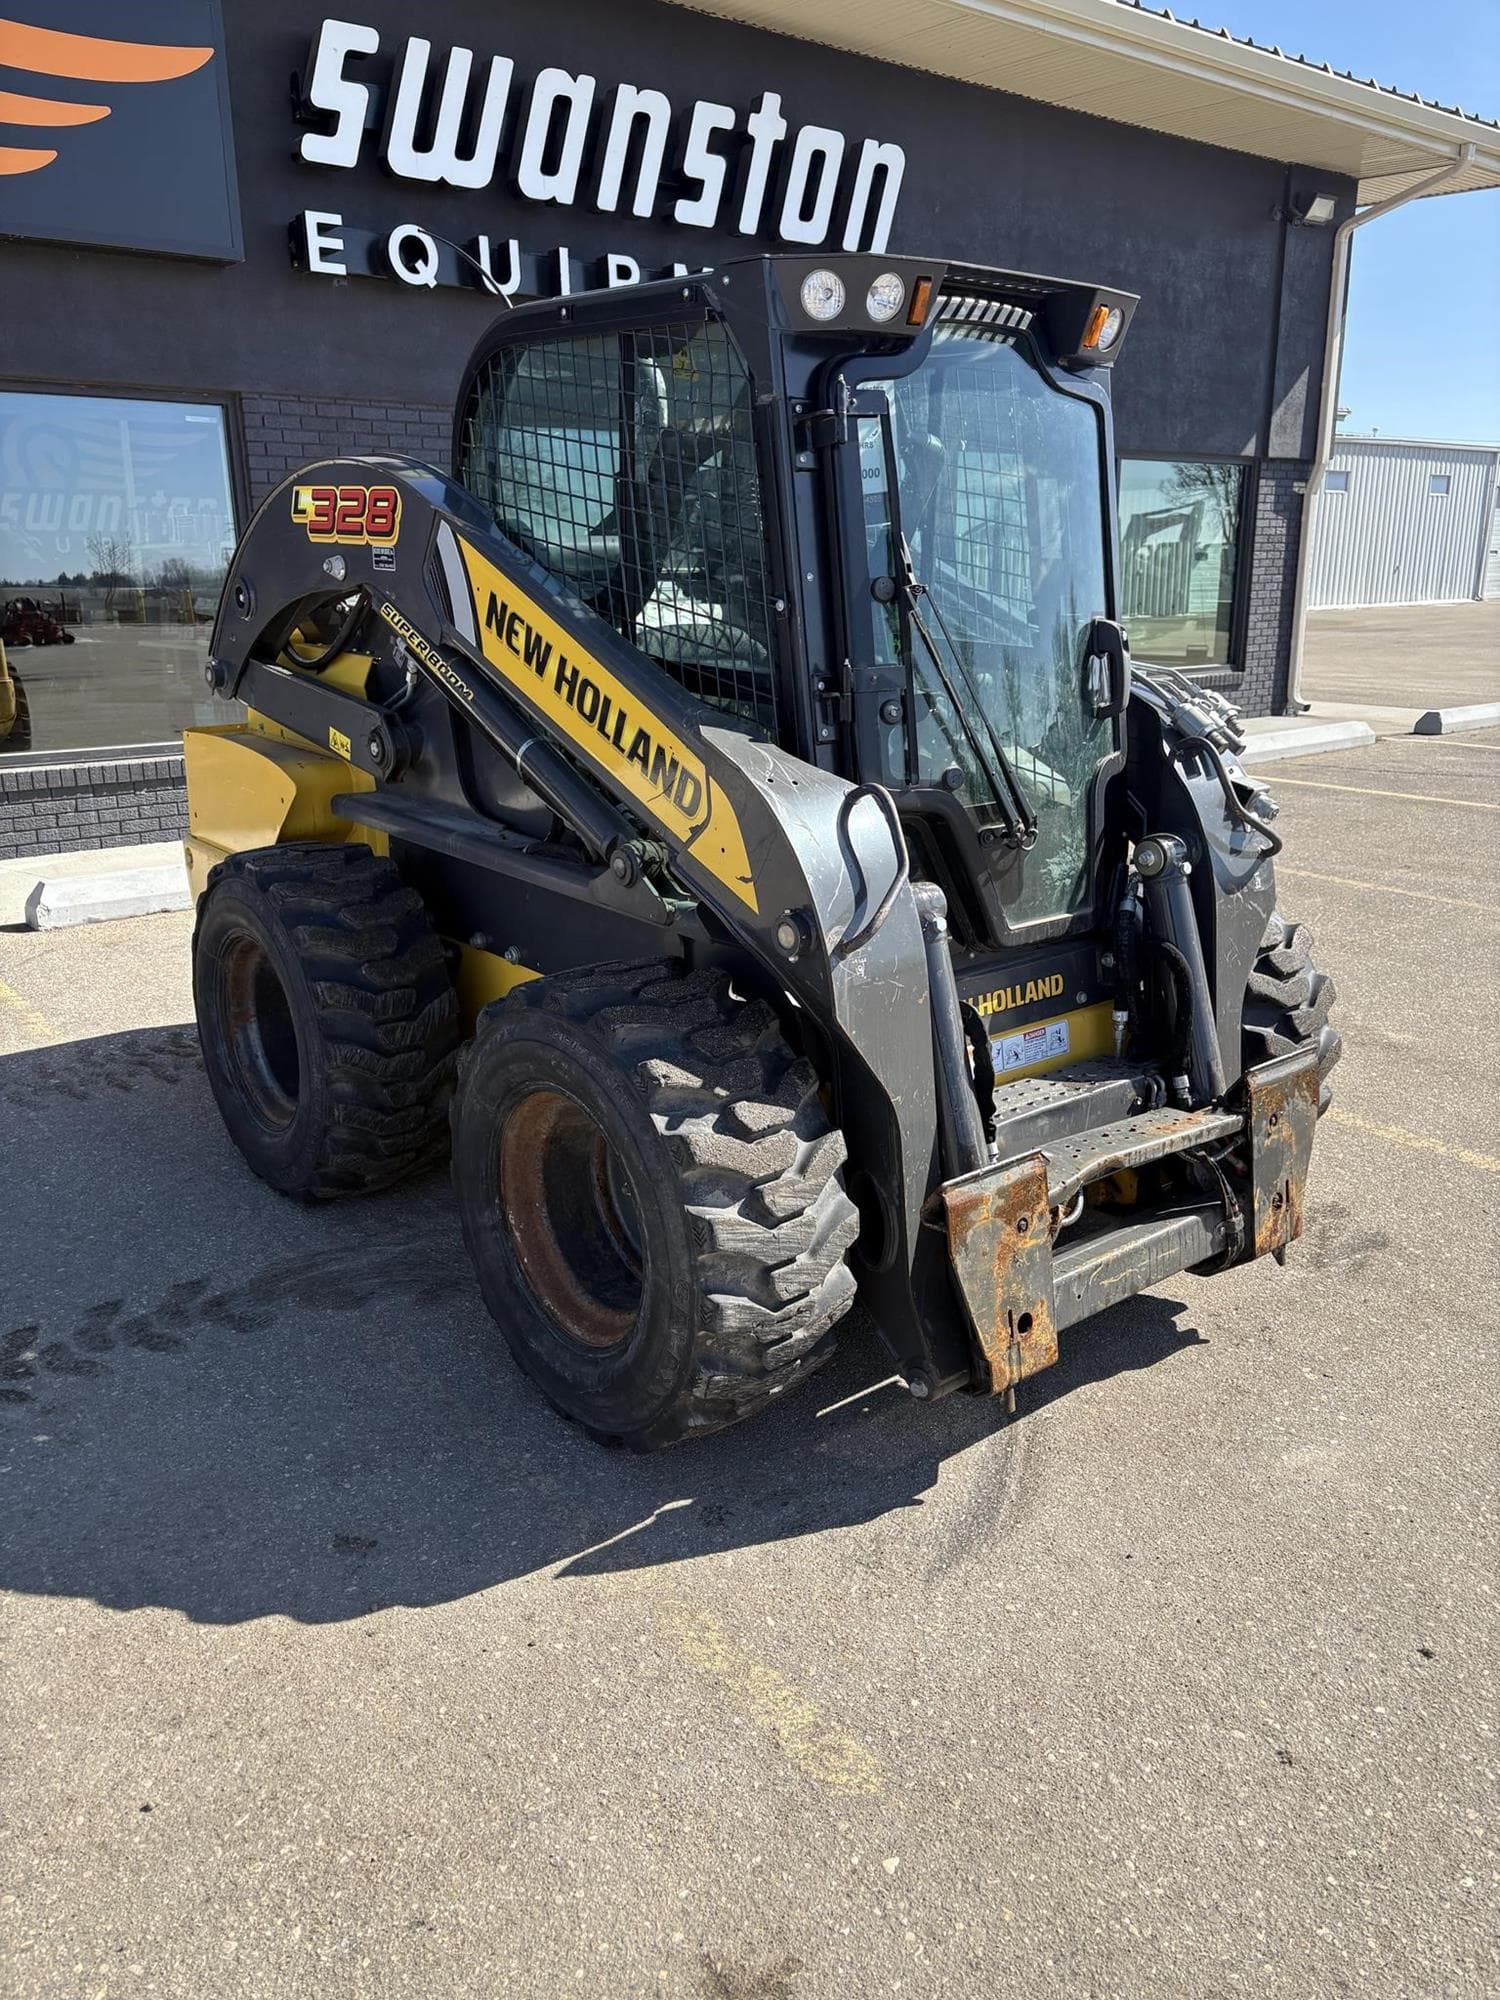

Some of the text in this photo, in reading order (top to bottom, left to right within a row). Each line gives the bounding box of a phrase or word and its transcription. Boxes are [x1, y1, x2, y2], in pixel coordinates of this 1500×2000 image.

[292, 487, 401, 544] L328
[485, 591, 702, 818] NEW HOLLAND
[976, 973, 1065, 1017] HOLLAND
